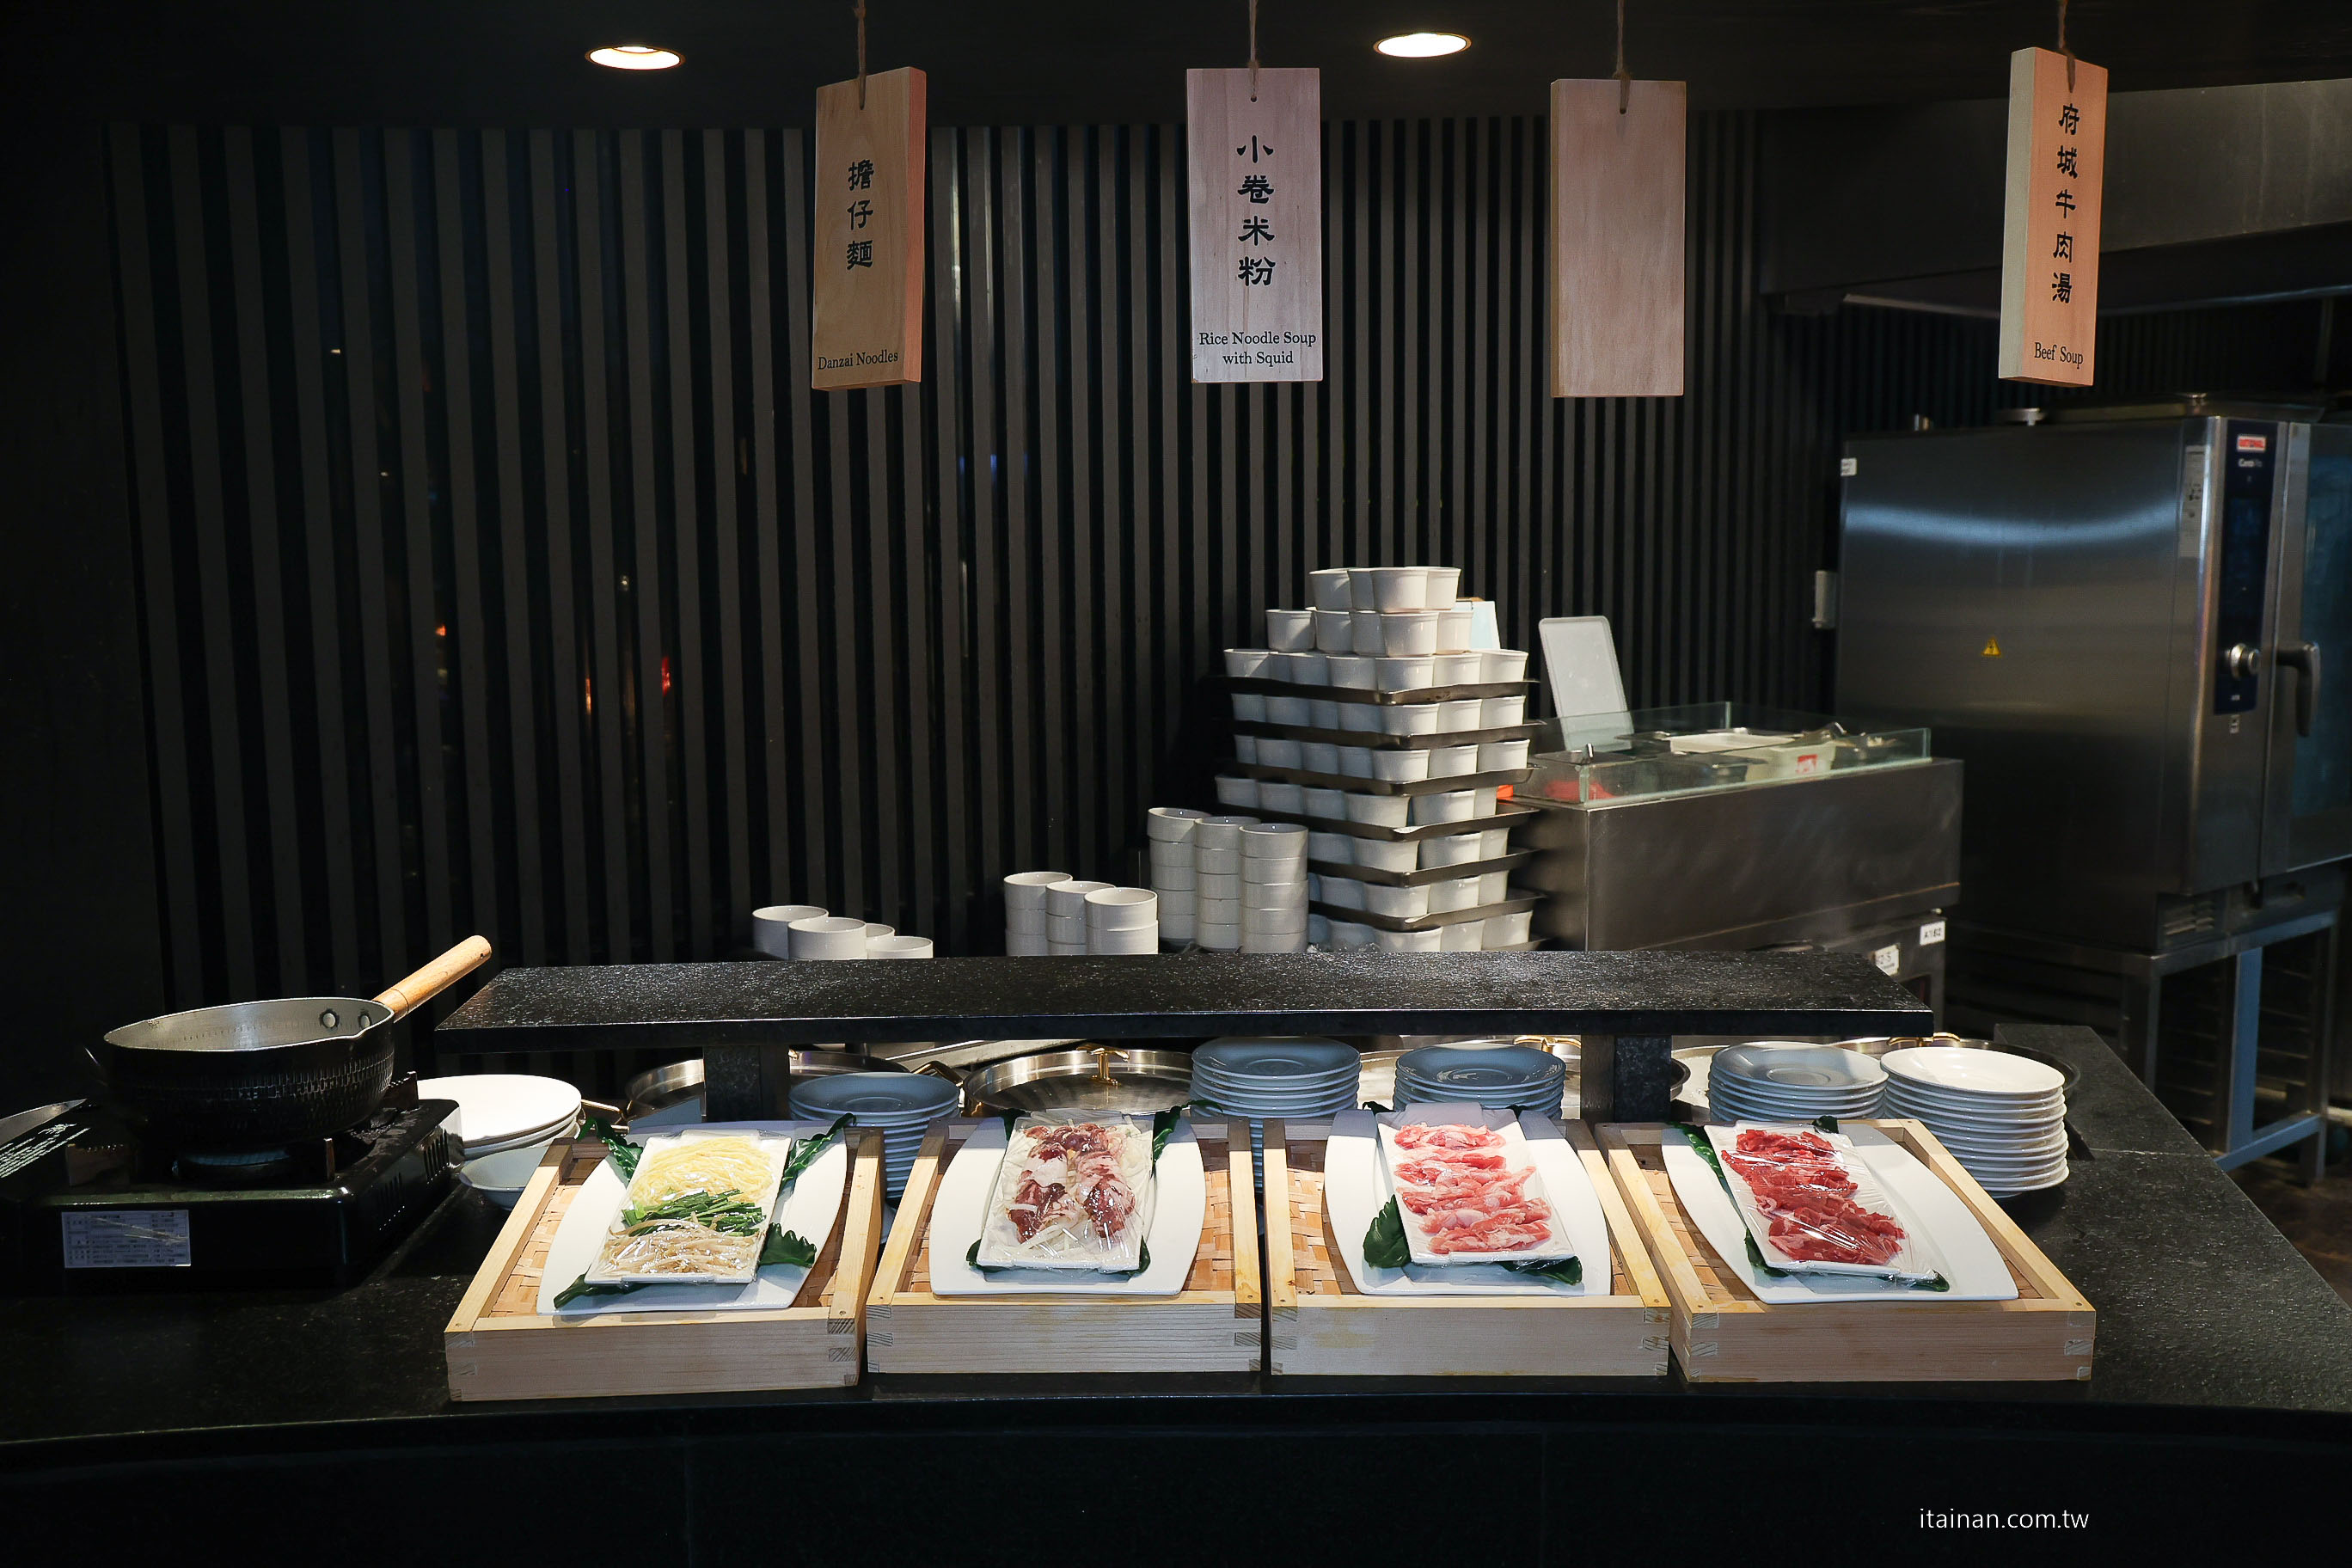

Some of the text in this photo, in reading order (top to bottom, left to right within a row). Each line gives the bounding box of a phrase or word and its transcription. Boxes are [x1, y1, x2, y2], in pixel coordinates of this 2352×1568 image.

[1236, 135, 1276, 287] 小卷米粉
[2051, 103, 2080, 304] 府城牛肉湯
[1199, 331, 1316, 347] Rice Noodle Soup
[818, 348, 898, 371] Danzai Noodles
[1222, 351, 1294, 367] with Squid
[2034, 342, 2084, 370] Beef Soup
